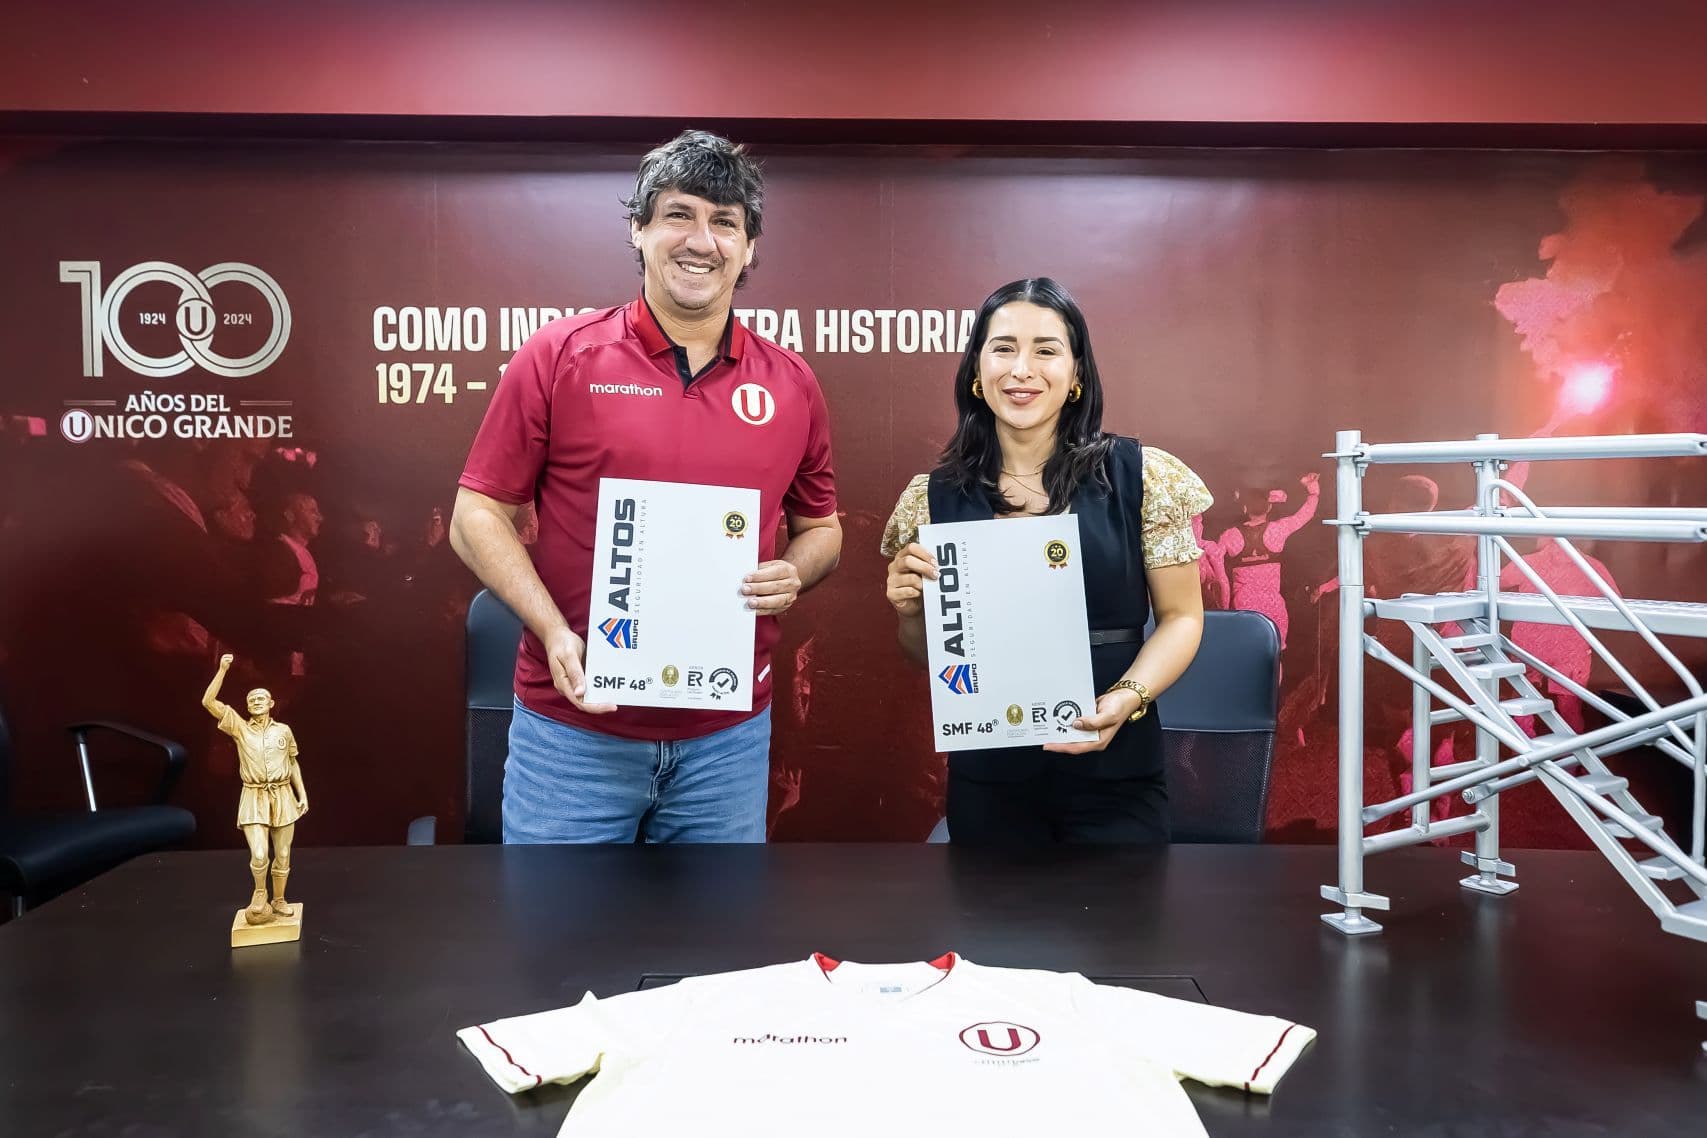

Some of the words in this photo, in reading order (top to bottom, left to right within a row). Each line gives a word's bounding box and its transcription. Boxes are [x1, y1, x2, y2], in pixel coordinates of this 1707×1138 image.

[139, 312, 166, 325] 1924
[184, 306, 208, 336] U
[223, 313, 252, 325] 2024
[373, 306, 487, 351] COMO
[815, 308, 977, 354] HISTORIA
[375, 363, 457, 404] 1974
[589, 382, 663, 397] marathon
[125, 390, 186, 412] AÑOS
[190, 394, 231, 412] DEL
[740, 389, 767, 421] U
[173, 415, 293, 438] GRANDE
[730, 518, 743, 527] 20
[608, 498, 636, 612] ALTOS
[1050, 548, 1064, 557] 20
[936, 542, 965, 657] ALTOS
[631, 619, 639, 650] GRUPO
[593, 675, 626, 690] SMF
[688, 671, 703, 687] ER
[971, 663, 979, 694] GRUPO
[1031, 707, 1047, 723] ER
[942, 721, 973, 736] SMF
[733, 1033, 848, 1045] marathon
[977, 1028, 1022, 1051] U
